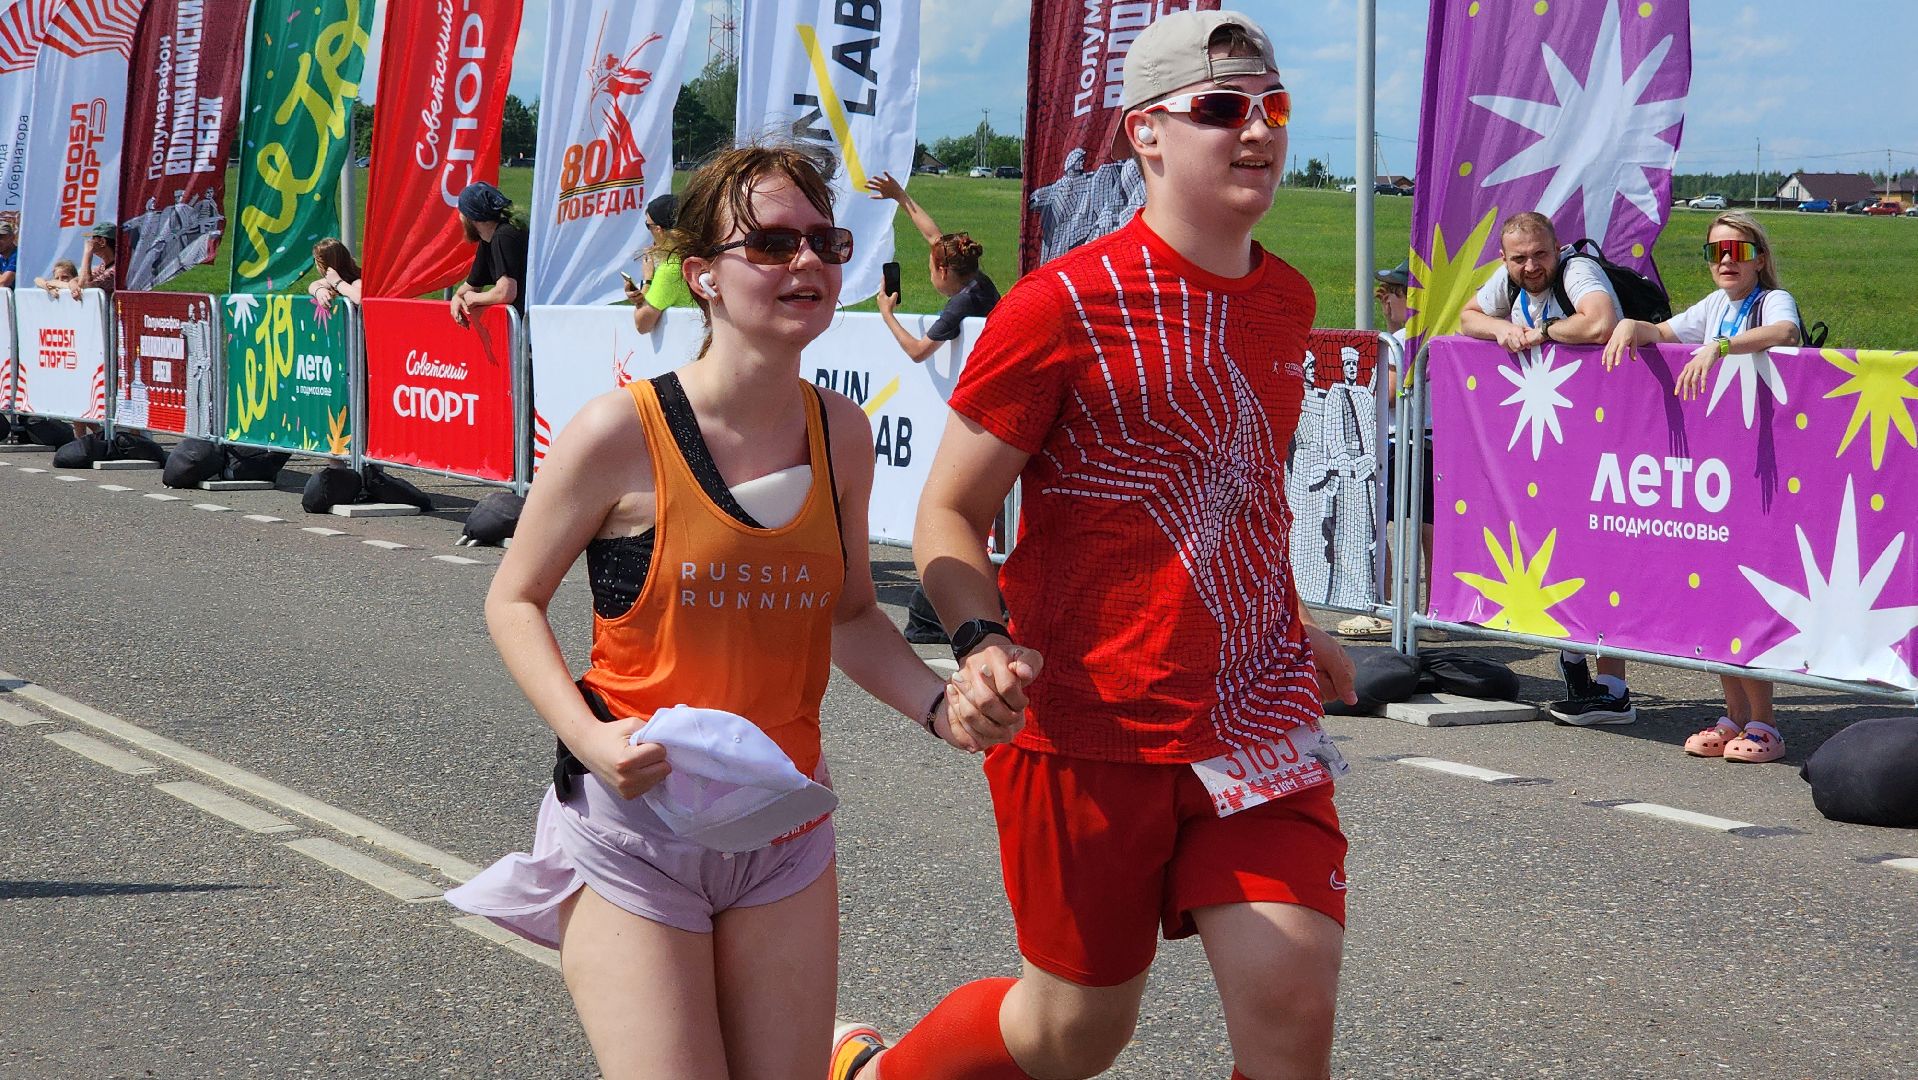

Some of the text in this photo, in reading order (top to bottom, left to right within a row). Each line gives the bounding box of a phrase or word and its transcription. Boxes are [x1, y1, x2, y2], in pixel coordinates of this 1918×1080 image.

[416, 0, 454, 170] Советский
[832, 0, 882, 117] LAB
[148, 35, 173, 180] Полумарафон
[193, 96, 224, 173] РУБЕЖ
[441, 0, 486, 208] СПОР
[5, 115, 29, 206] Губернатора
[60, 103, 88, 228] МОСОБЛ
[560, 139, 608, 192] 80
[792, 93, 838, 182] UN
[78, 130, 104, 226] СПОРТ
[557, 187, 644, 225] ПОБЕДА!
[39, 329, 75, 348] МОСОБЛ
[39, 351, 67, 369] СПОРТ
[406, 349, 468, 380] Советский
[392, 384, 479, 426] СПОРТ
[875, 415, 912, 468] AB
[1603, 515, 1730, 542] подмосковье
[681, 561, 810, 583] RUSSIA
